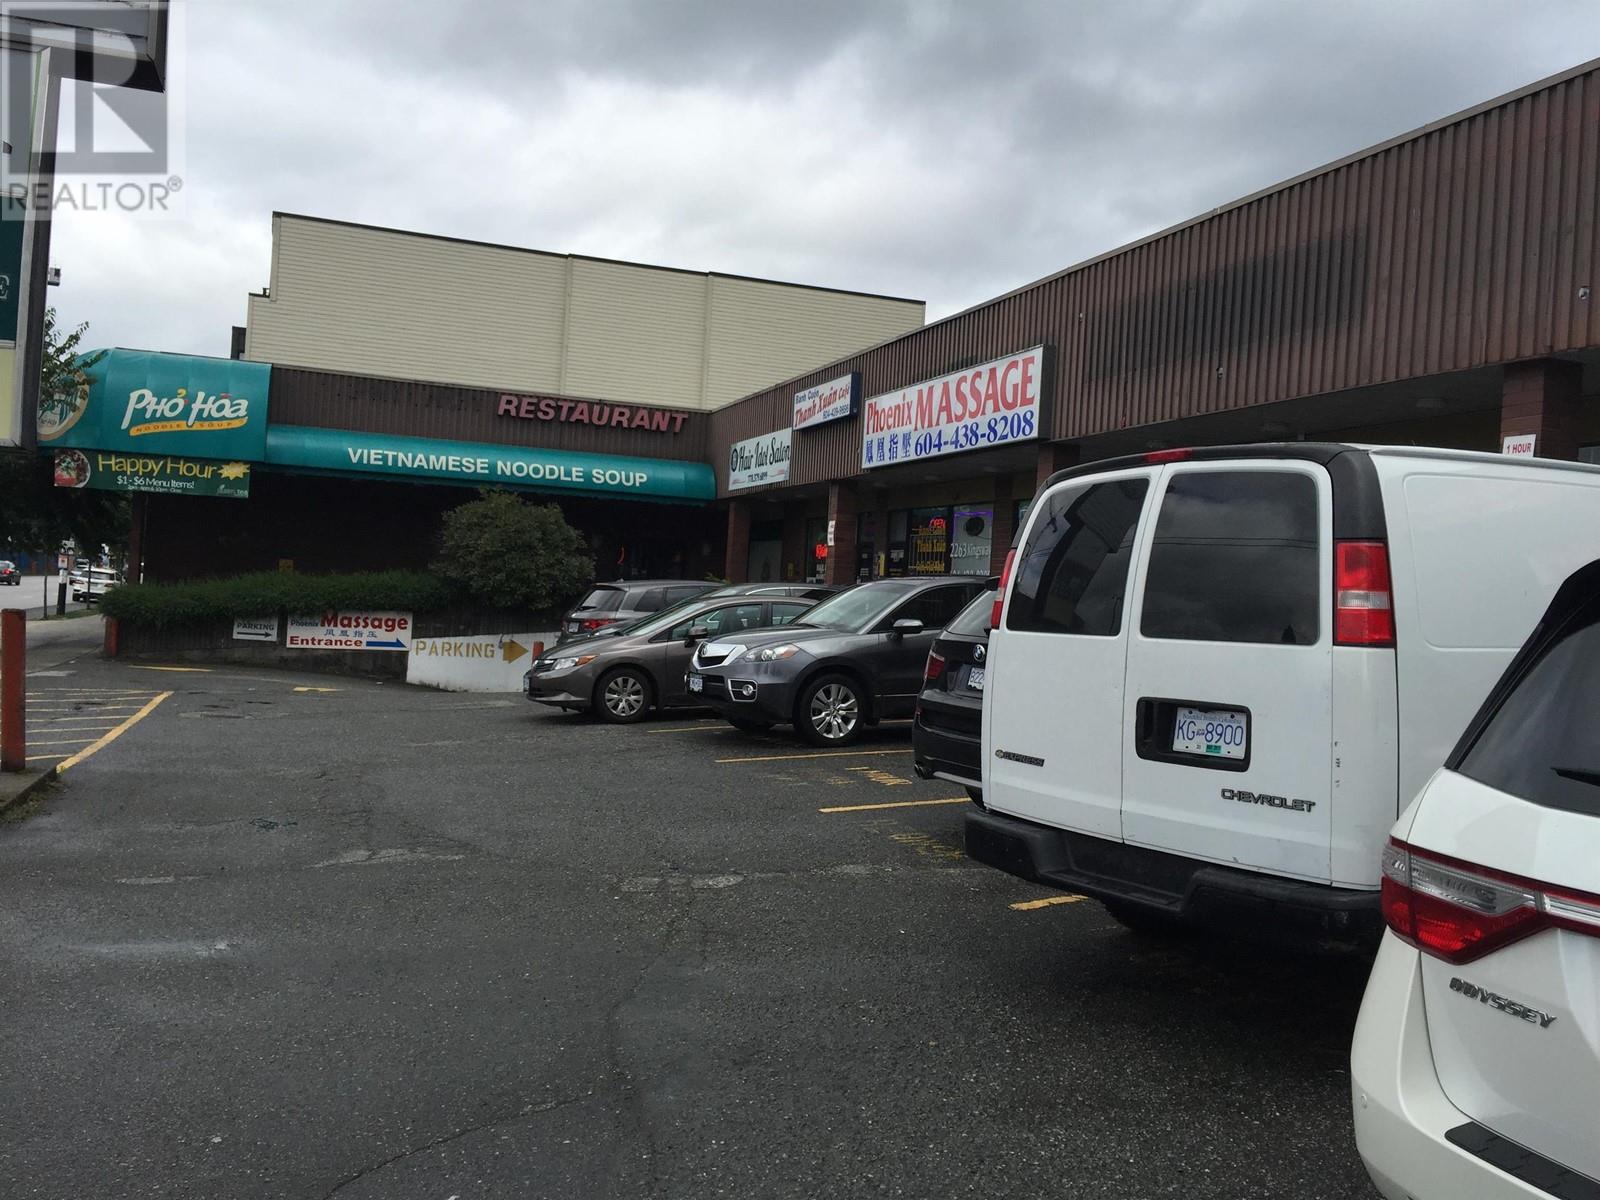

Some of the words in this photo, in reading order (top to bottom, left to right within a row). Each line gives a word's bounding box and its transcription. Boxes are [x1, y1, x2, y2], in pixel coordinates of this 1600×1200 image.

[866, 392, 913, 435] Phoenix
[913, 356, 1036, 432] MASSAGE
[497, 394, 689, 433] RESTAURANT
[914, 410, 1035, 457] 604-438-8208
[1512, 443, 1532, 454] HOUR
[98, 454, 165, 477] Happy
[166, 457, 217, 479] Hour
[347, 448, 490, 475] VIETNAMESE
[496, 460, 584, 483] NOODLE
[591, 468, 648, 488] SOUP
[116, 475, 128, 485] $1
[145, 477, 171, 487] Menu
[237, 622, 275, 631] PARKING
[320, 611, 409, 632] Massage
[289, 636, 363, 647] Entrance
[415, 640, 496, 659] PARKING
[1220, 789, 1316, 813] CHEVROLET
[1449, 977, 1557, 1028] ODYSSEY
